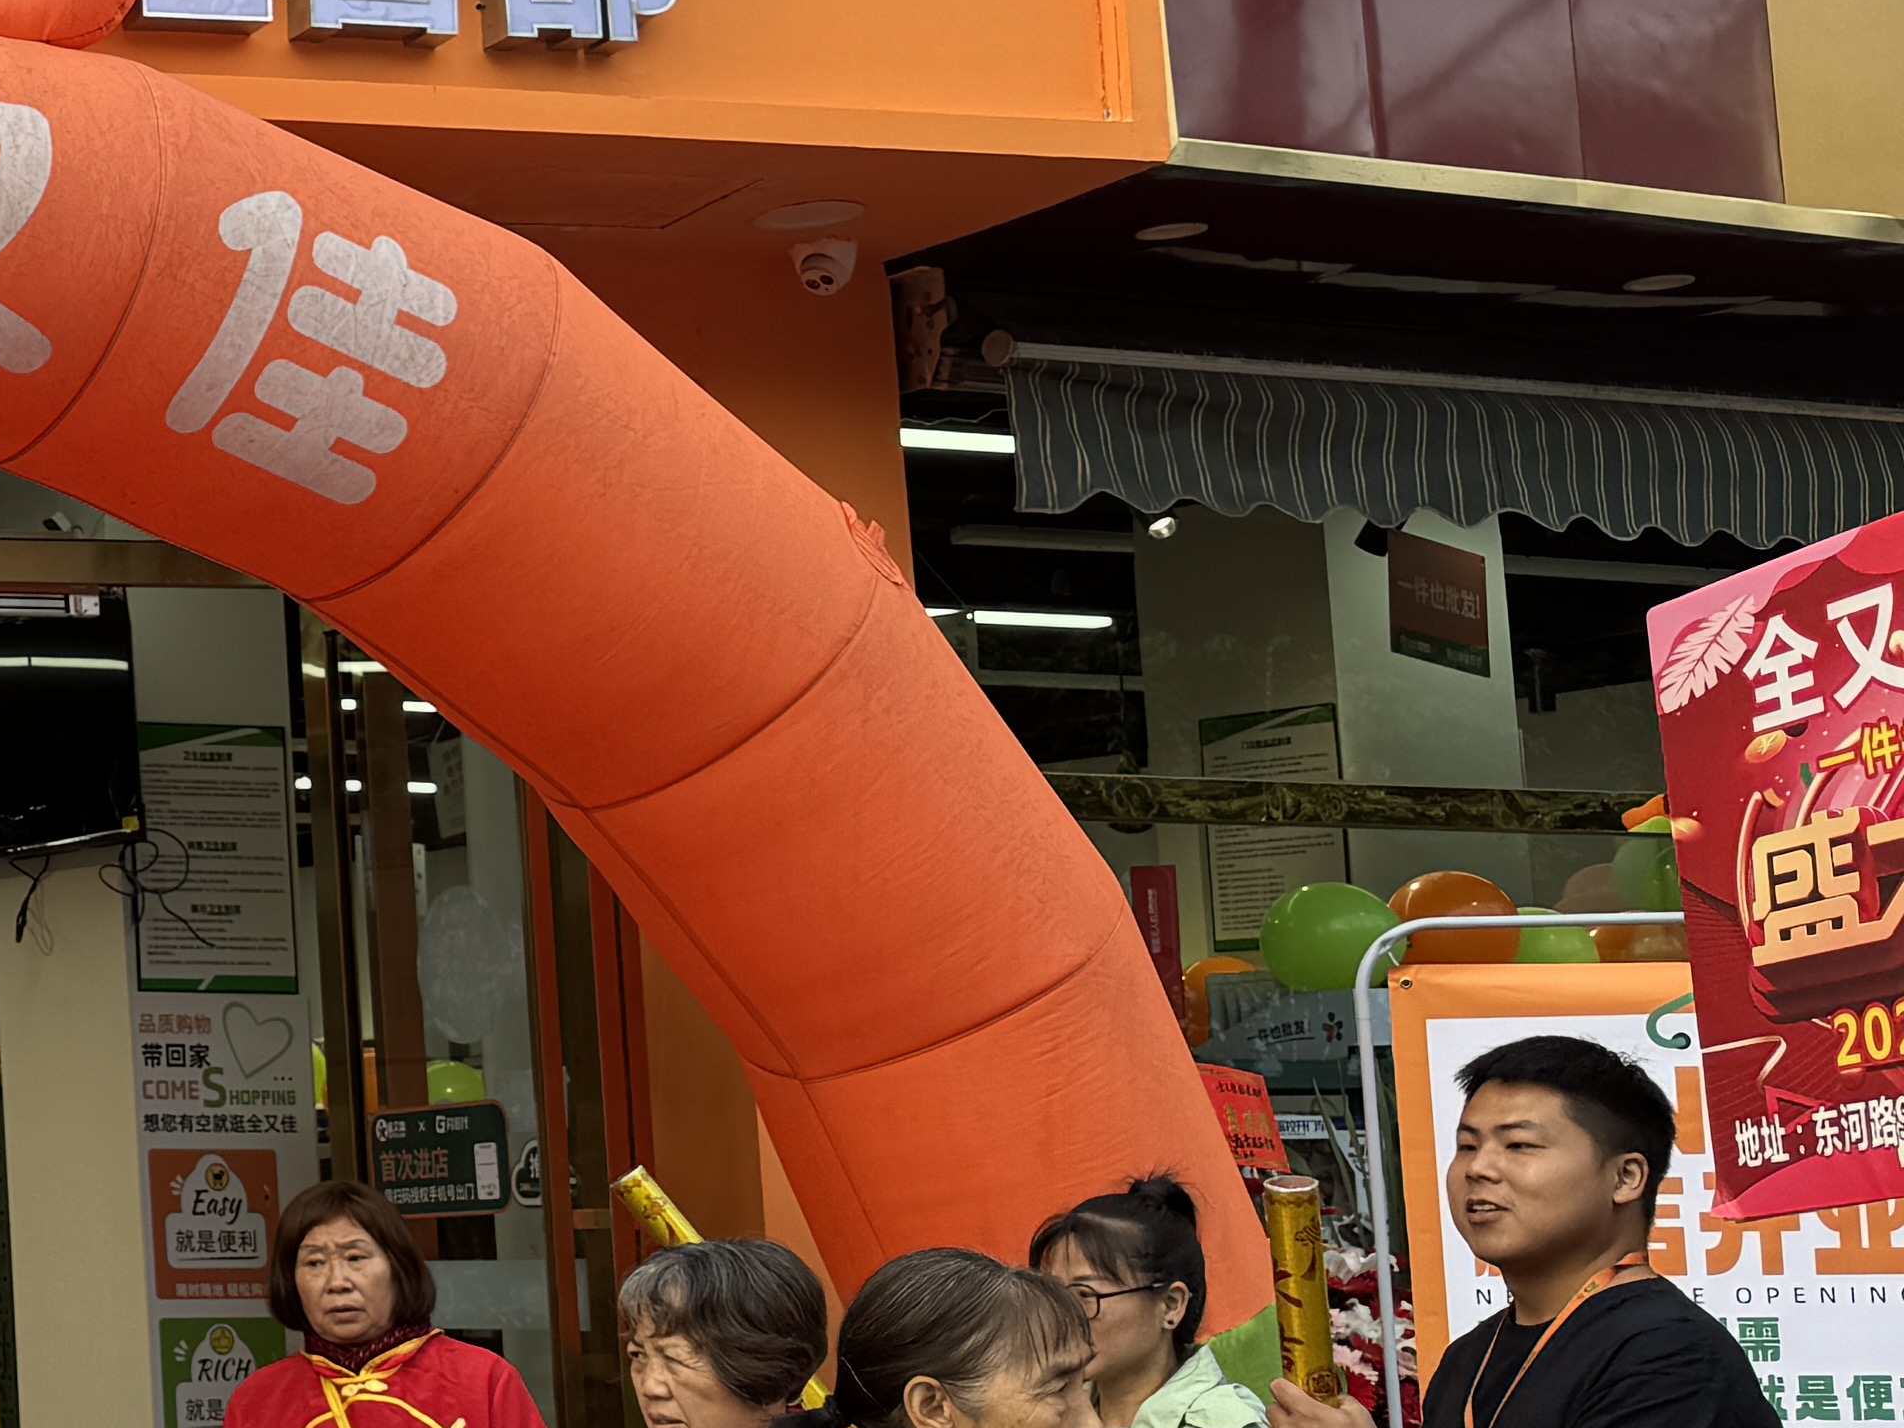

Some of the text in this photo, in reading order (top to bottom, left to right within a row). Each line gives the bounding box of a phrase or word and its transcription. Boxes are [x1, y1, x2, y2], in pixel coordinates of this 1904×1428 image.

[139, 1013, 212, 1035] 品质购物
[141, 1042, 211, 1069] 带回家
[142, 1080, 199, 1101] COME
[143, 1113, 298, 1135] 想您有空就逛全又佳
[192, 1188, 243, 1225] Easy
[175, 1228, 257, 1254] 就是便利
[1720, 1317, 1781, 1362] 需
[198, 1356, 252, 1383] RICH
